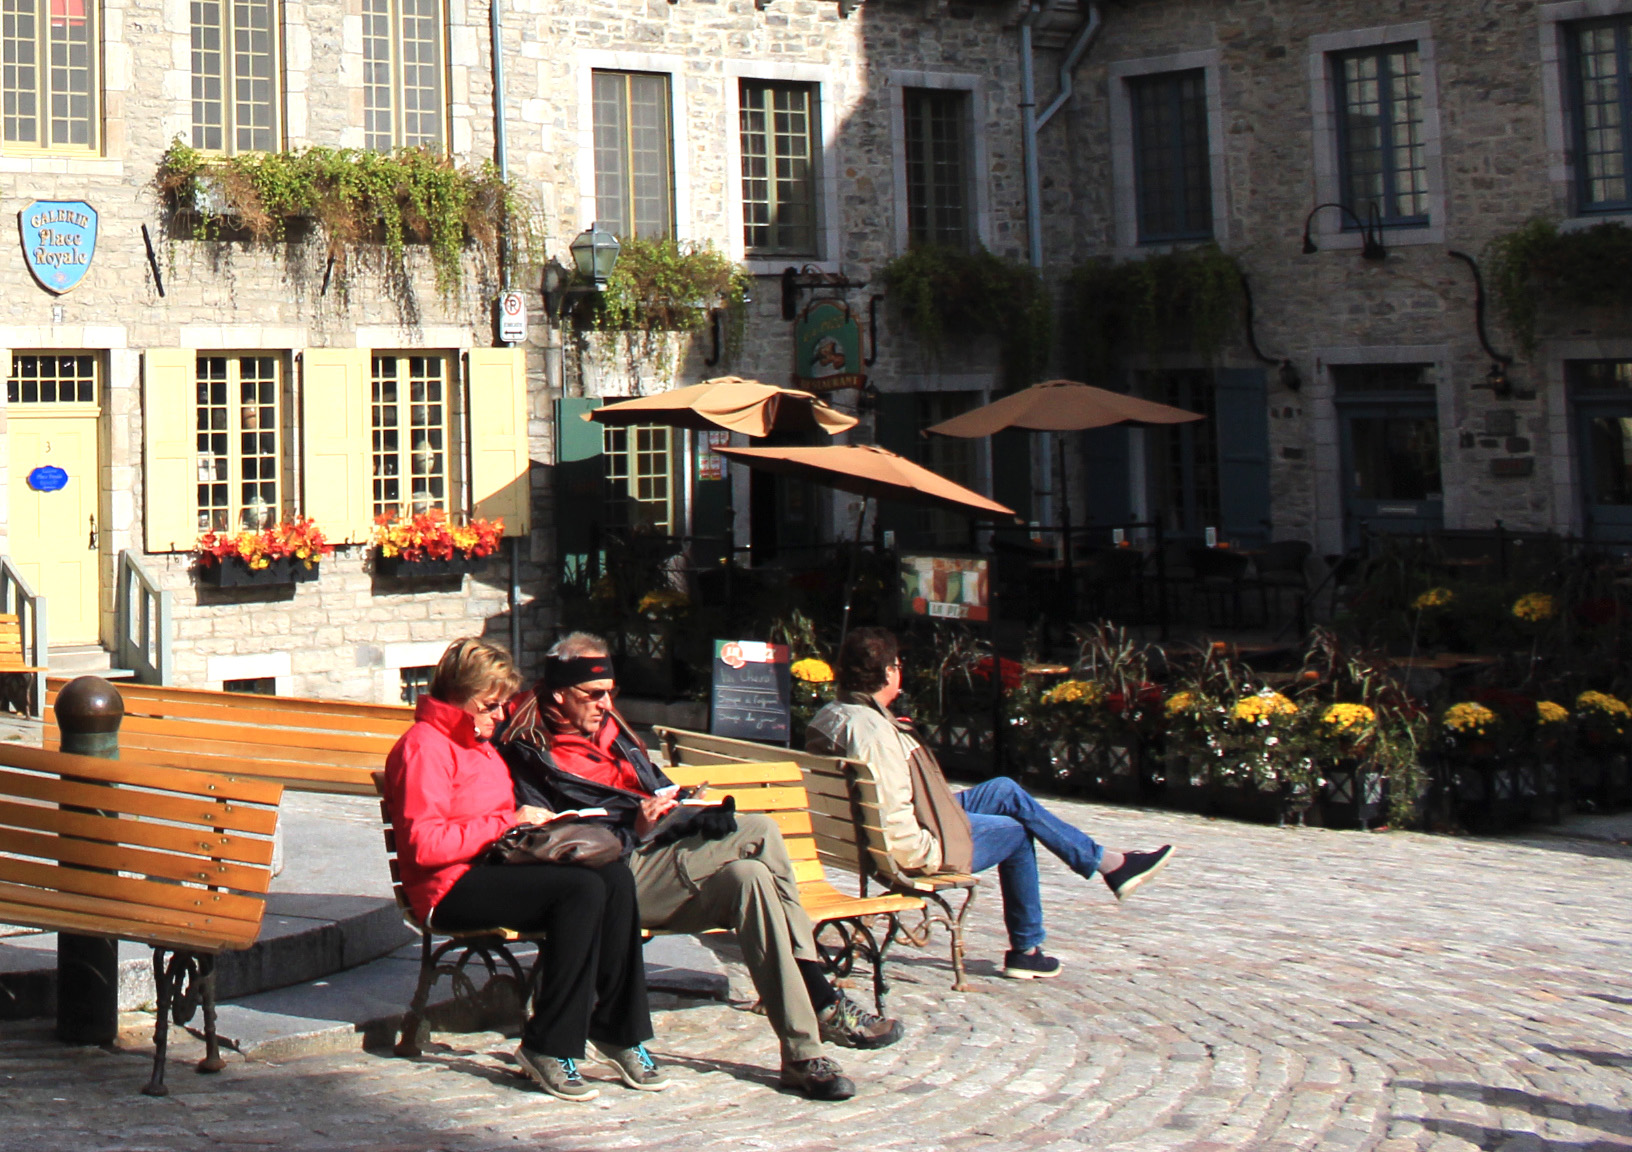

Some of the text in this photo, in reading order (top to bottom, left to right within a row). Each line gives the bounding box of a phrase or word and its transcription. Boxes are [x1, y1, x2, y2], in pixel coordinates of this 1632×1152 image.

[31, 209, 88, 229] GALERIE
[38, 228, 82, 246] Place
[33, 247, 88, 269] Royale
